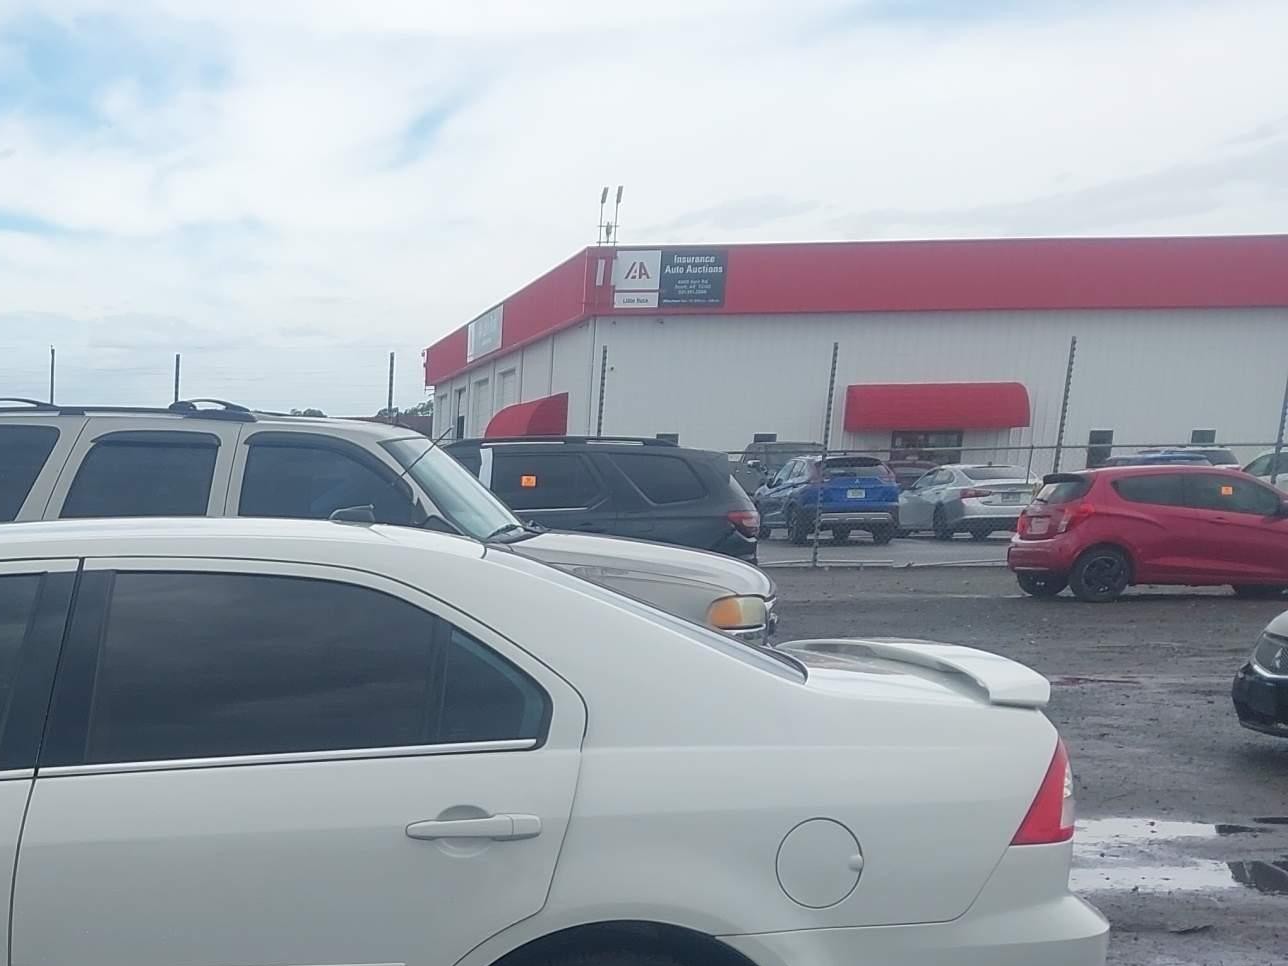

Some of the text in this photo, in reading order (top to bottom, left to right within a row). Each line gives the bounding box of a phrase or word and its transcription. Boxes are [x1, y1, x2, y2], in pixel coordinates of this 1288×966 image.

[674, 254, 716, 264] Insurance
[665, 265, 723, 274] Auto Auctions
